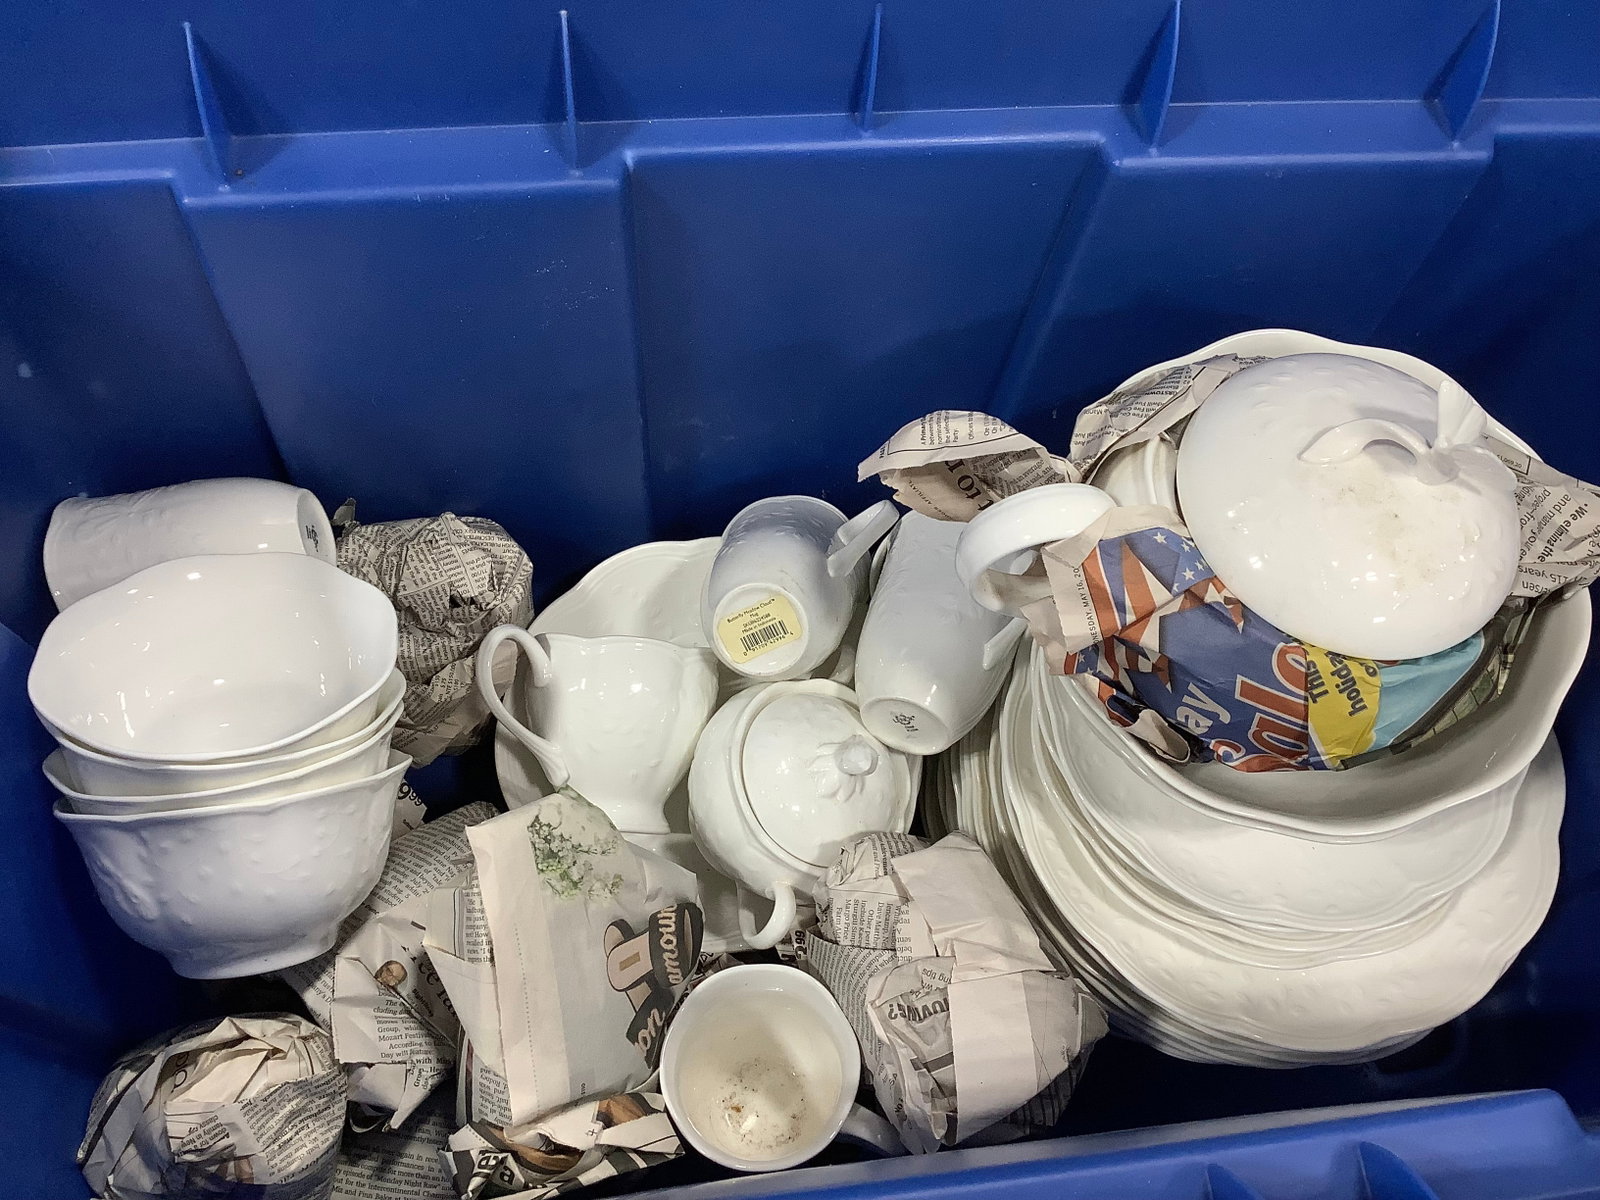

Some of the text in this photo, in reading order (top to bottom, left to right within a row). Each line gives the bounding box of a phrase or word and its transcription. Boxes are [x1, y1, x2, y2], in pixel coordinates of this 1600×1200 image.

[953, 471, 983, 503] to
[1551, 493, 1572, 514] and
[1569, 505, 1587, 523] We
[1536, 544, 1554, 565] the
[1071, 565, 1081, 578] 20
[1517, 563, 1547, 578] years
[1075, 579, 1085, 590] 16,
[1079, 591, 1089, 608] MAY
[726, 612, 744, 623] Butterfly
[742, 604, 759, 615] Meadow
[749, 611, 758, 619] Mug
[741, 625, 753, 634] Made
[756, 615, 776, 627] Indonesia
[1307, 649, 1332, 705] This
[432, 854, 448, 868] Lane
[432, 864, 445, 877] and
[408, 876, 423, 889] July
[382, 886, 404, 904] student
[843, 898, 851, 921] Margo
[850, 898, 859, 925] Sturgill
[859, 900, 867, 926] Include
[874, 902, 883, 920] Dave
[866, 909, 874, 929] Other
[920, 967, 936, 978] tips
[372, 1006, 397, 1015] cluding
[377, 1025, 400, 1033] Group,
[377, 1032, 402, 1041] Mozart
[388, 1039, 423, 1049] According
[379, 1048, 408, 1059] Day will
[197, 1113, 219, 1130] classy
[201, 1119, 223, 1137] family
[194, 1132, 203, 1141] in
[207, 1126, 227, 1141] down
[179, 1136, 196, 1150] New
[198, 1138, 209, 1148] for
[341, 1168, 365, 1180] episode
[403, 1178, 422, 1189] Night
[396, 1169, 414, 1177] more
[414, 1171, 431, 1180] than
[344, 1186, 357, 1196] and
[367, 1182, 421, 1197] Intercontinental
